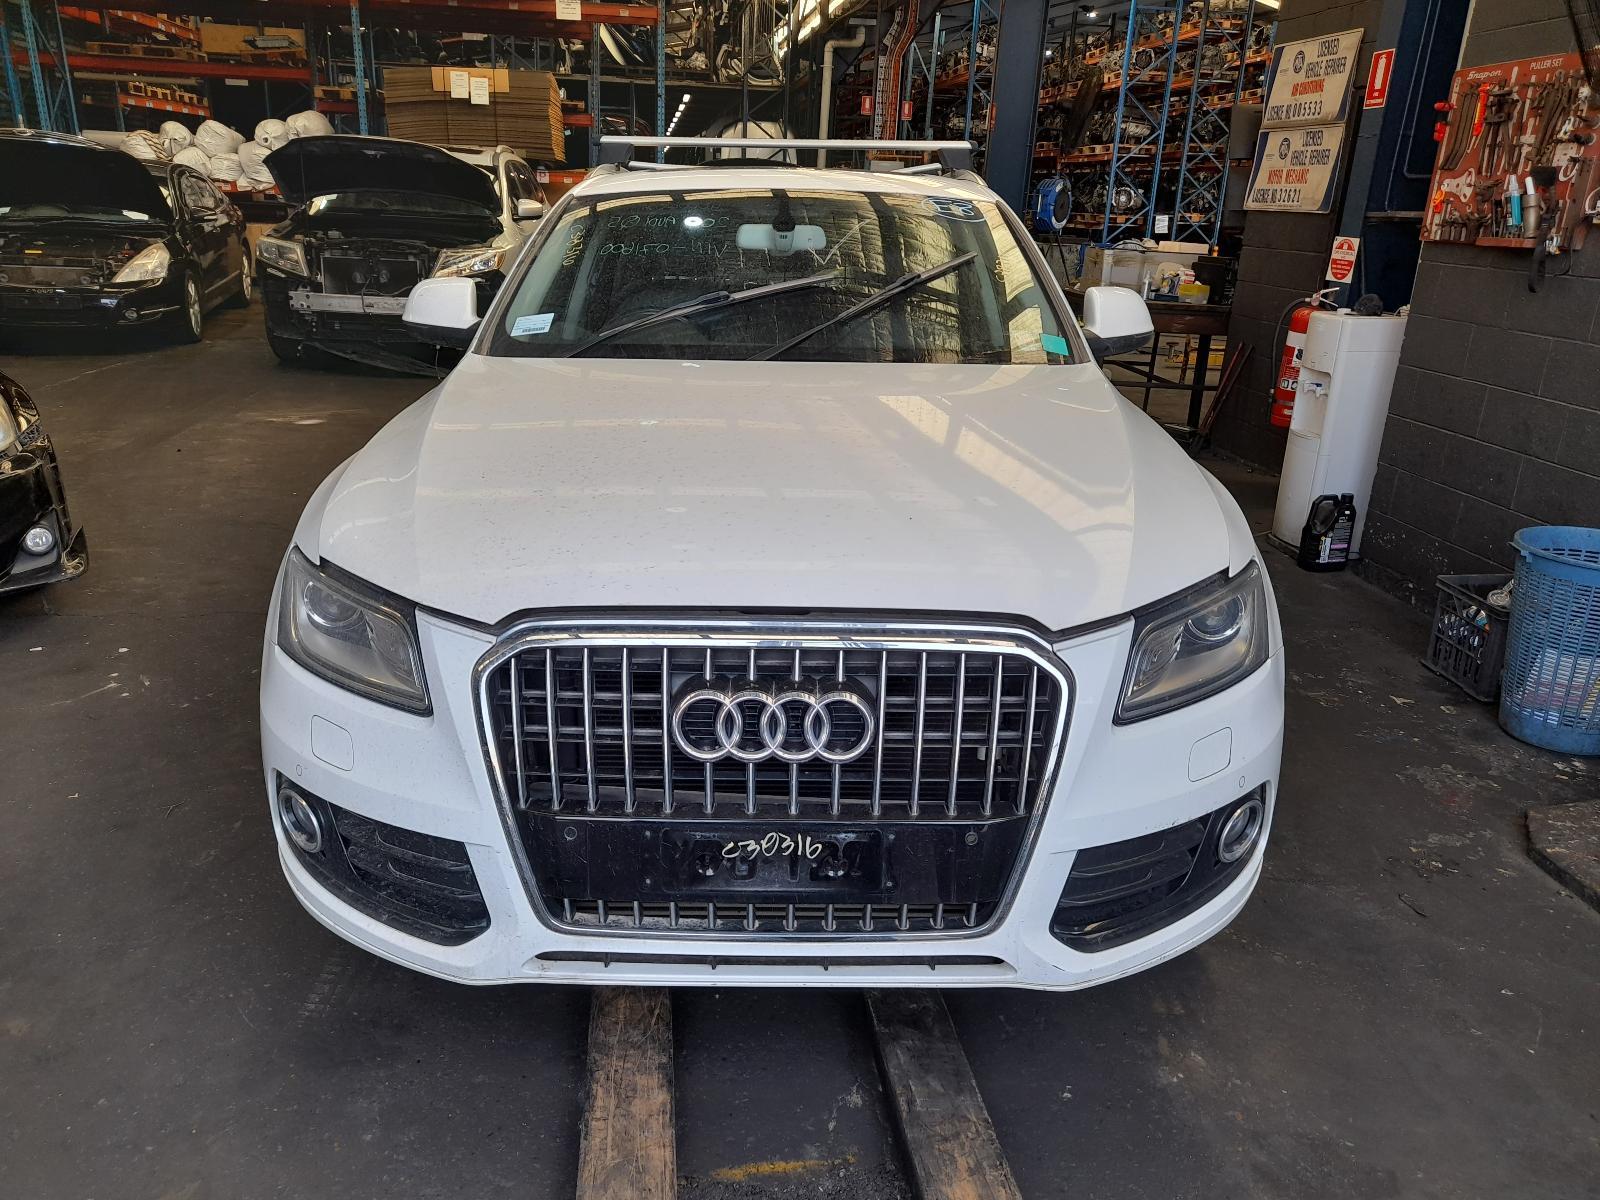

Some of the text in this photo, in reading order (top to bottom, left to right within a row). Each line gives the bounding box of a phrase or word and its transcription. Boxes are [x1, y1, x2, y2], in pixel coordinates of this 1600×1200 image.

[1317, 38, 1340, 58] LICENSED
[1305, 60, 1323, 79] VEHICLE
[1530, 58, 1564, 70] PULLER SET
[1302, 129, 1324, 147] LICENSED
[1290, 149, 1309, 167] VEHICLE
